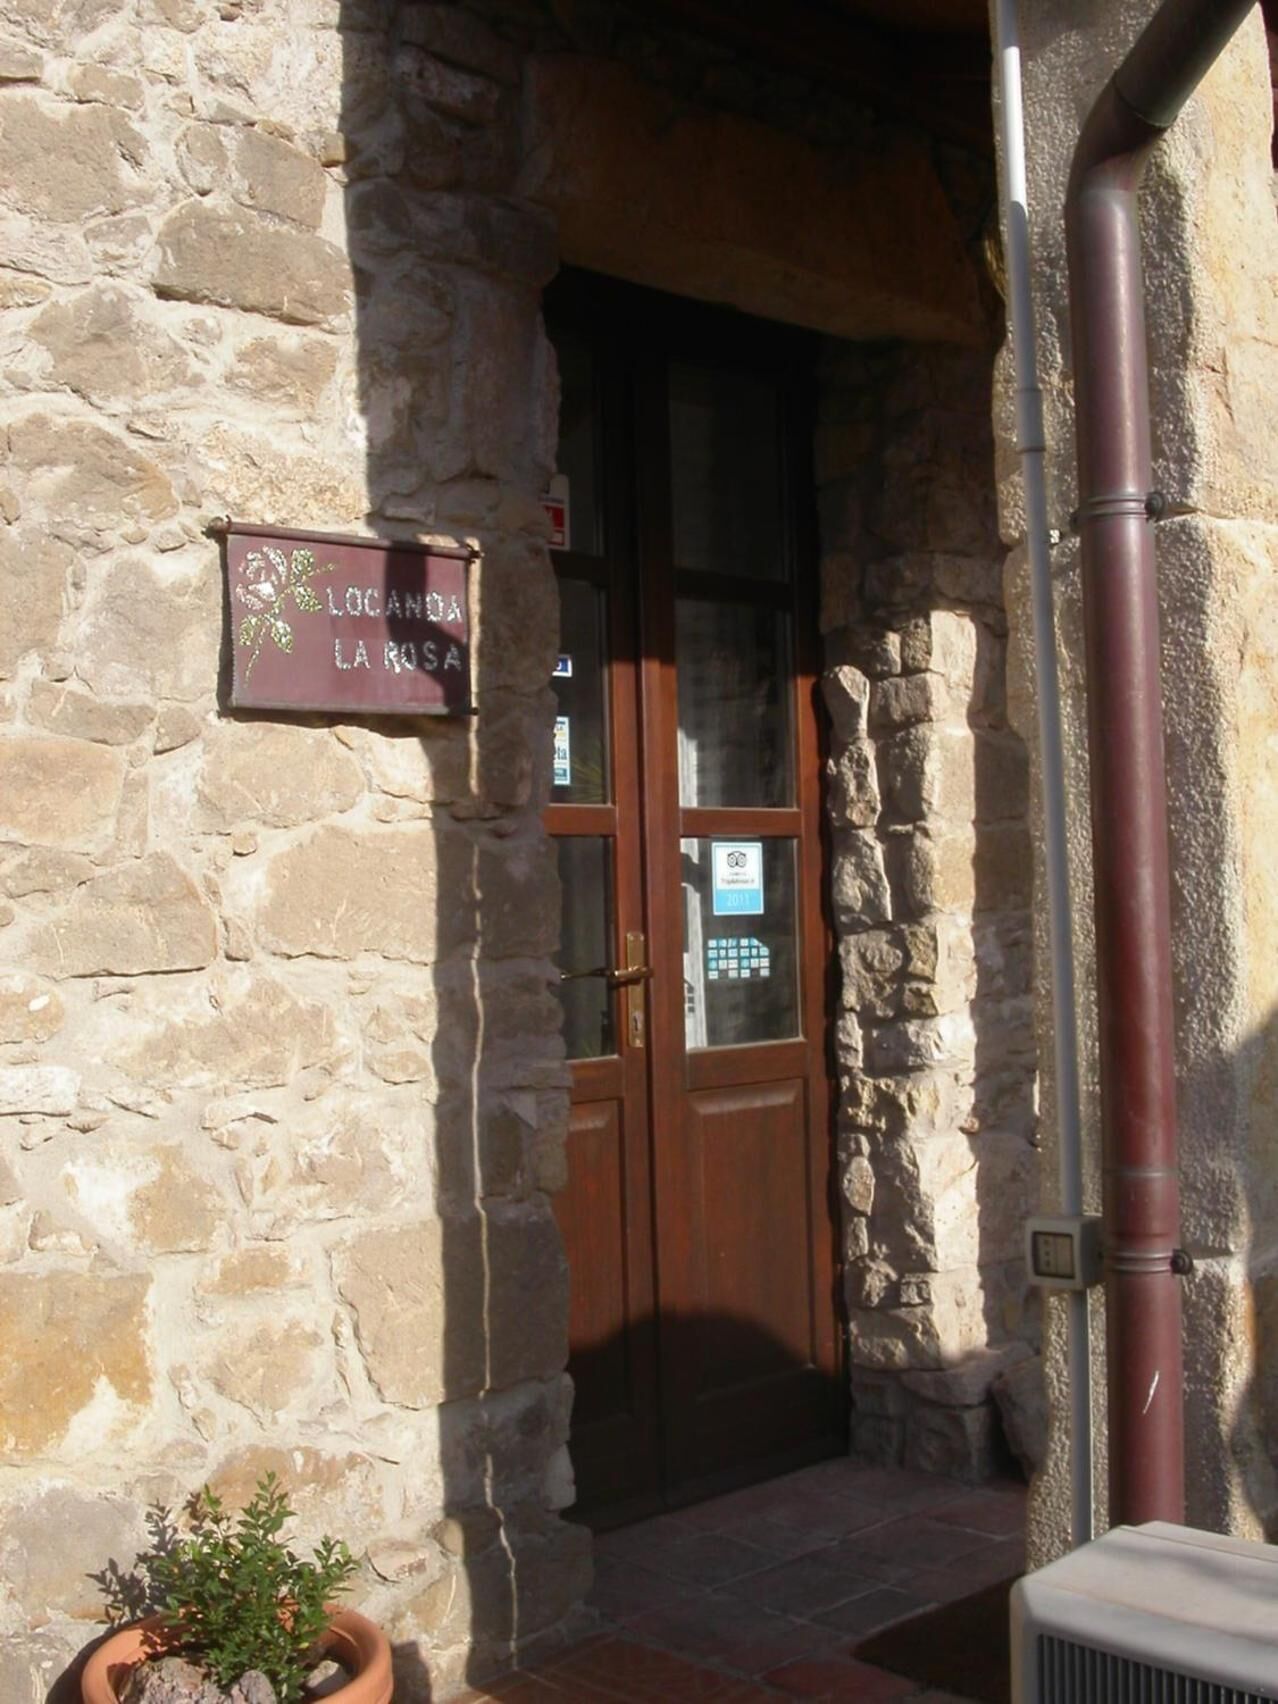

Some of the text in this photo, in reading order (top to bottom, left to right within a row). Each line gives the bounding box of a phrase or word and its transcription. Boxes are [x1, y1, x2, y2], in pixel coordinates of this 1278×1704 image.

[326, 586, 462, 622] LOCANDA
[334, 638, 461, 673] LA ROSA
